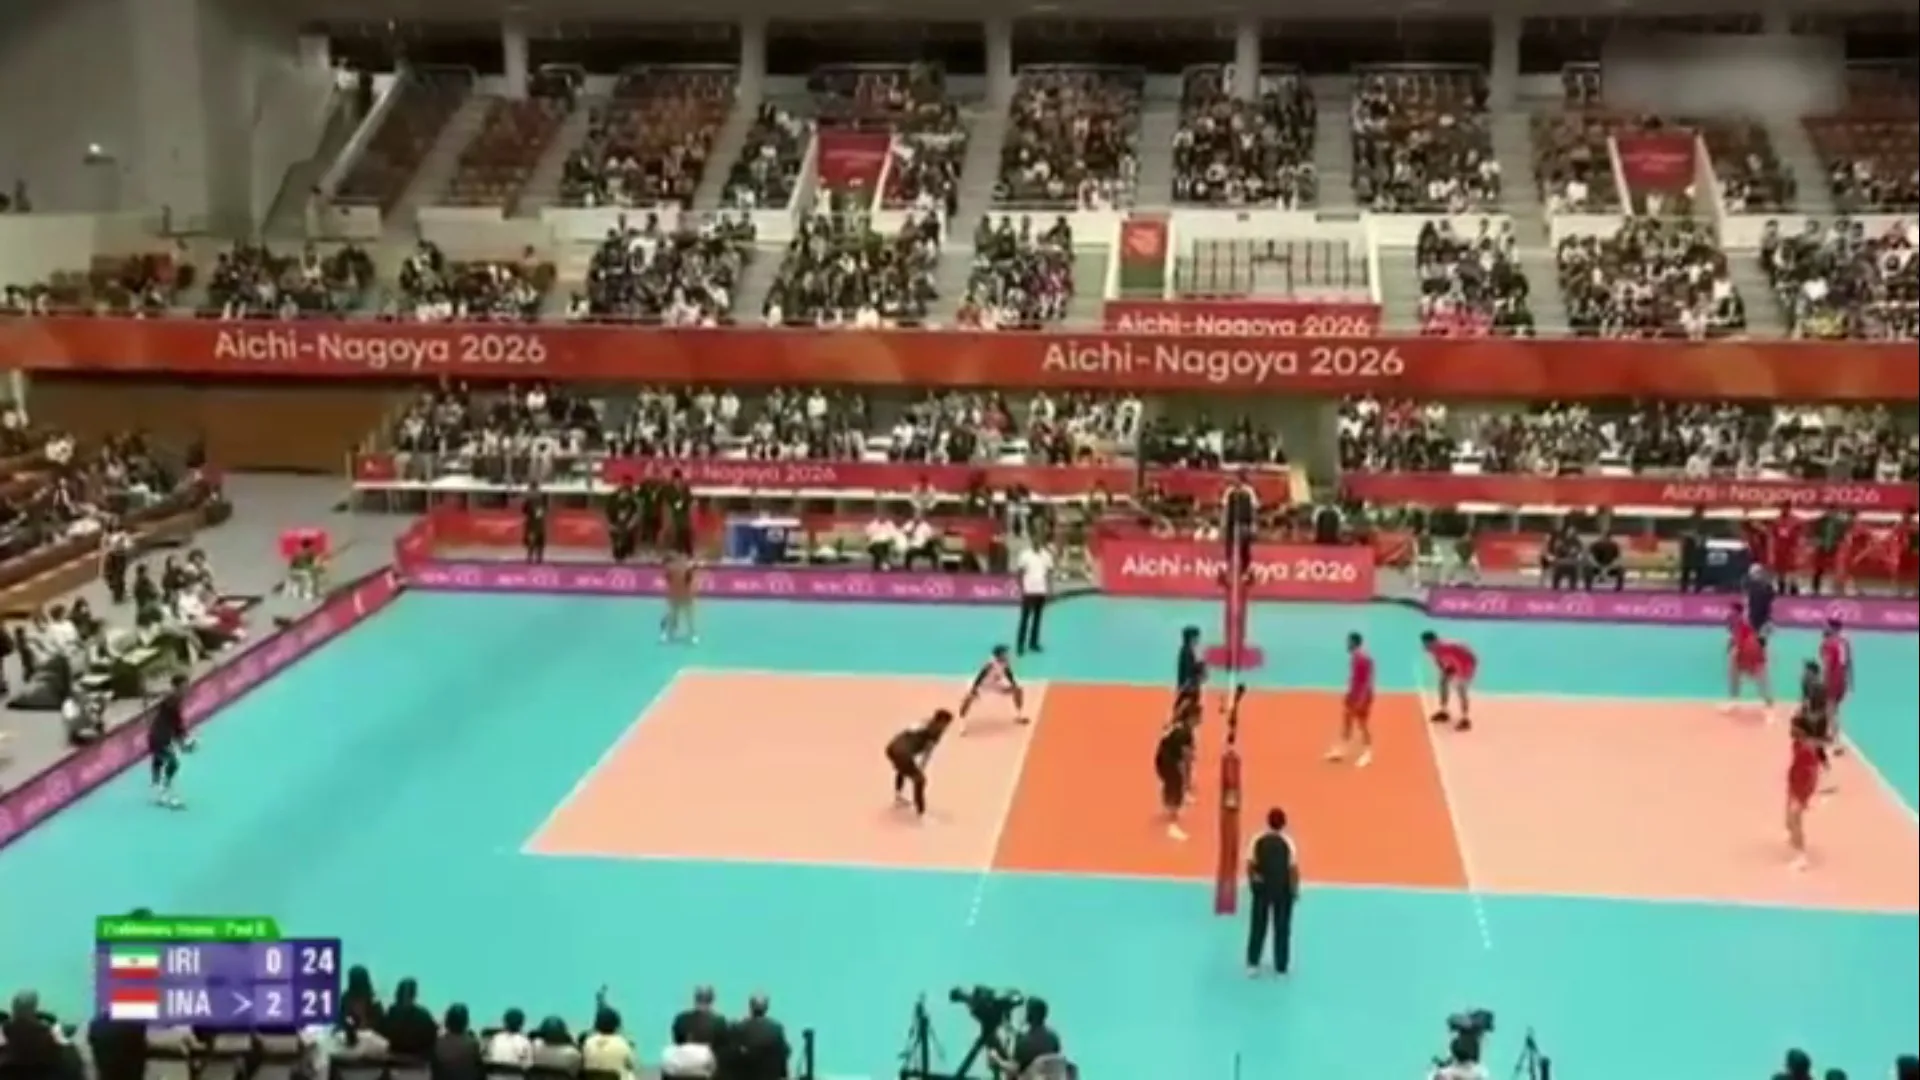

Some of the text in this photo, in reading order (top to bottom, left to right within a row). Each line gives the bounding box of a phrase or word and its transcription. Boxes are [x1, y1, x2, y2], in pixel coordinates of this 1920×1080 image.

[1304, 315, 1371, 337] 2026
[214, 330, 547, 369] Aichi-Nagoya 2026
[1042, 341, 1405, 382] Aichi-Nagoya 2026
[785, 464, 838, 484] 2026
[1662, 482, 1881, 507] Aichi-Nagoya 2026
[1294, 557, 1357, 583] 2026
